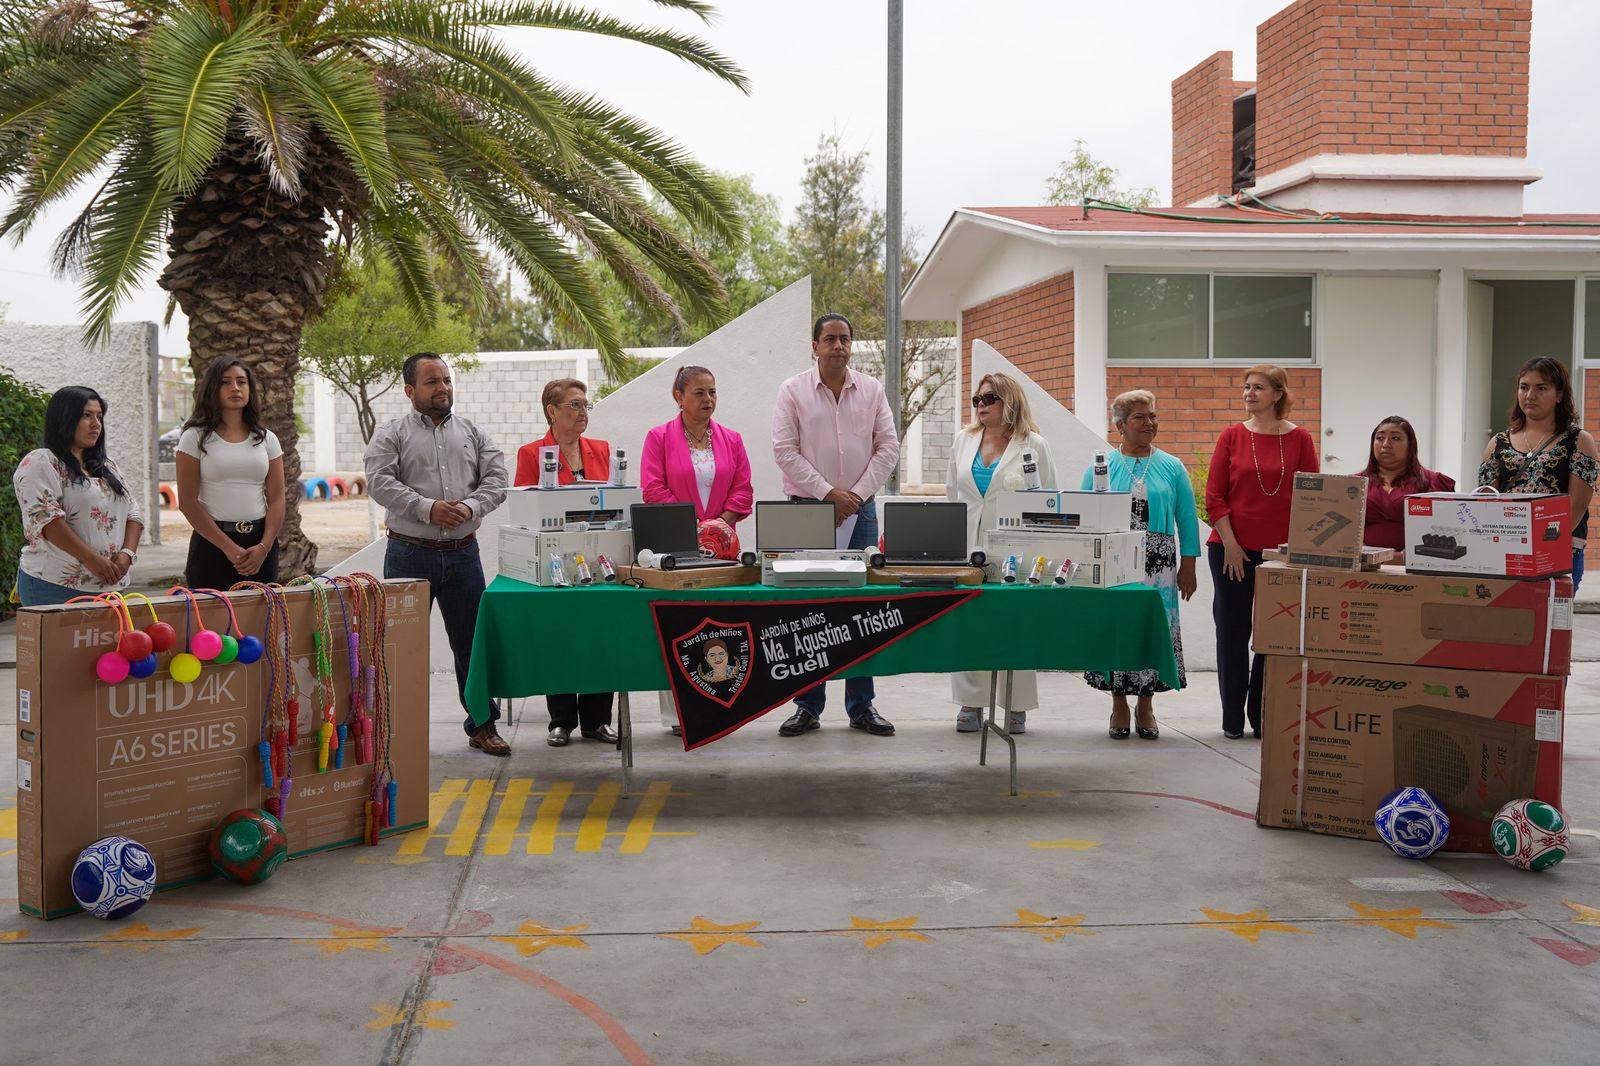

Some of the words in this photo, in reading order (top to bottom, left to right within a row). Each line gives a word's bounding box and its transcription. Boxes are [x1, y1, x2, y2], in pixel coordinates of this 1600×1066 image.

[1368, 582, 1415, 592] mirage
[682, 632, 708, 648] Jardín
[720, 628, 742, 637] Niños
[760, 619, 789, 640] JARDÍN
[790, 621, 801, 632] DE
[801, 612, 826, 628] NIÑOS
[762, 639, 789, 664] Ma.
[794, 624, 852, 658] Agustina
[852, 602, 904, 638] Tristán
[770, 651, 830, 680] Guell
[108, 678, 194, 718] UHD
[196, 671, 236, 705] 4K
[689, 670, 717, 696] Agustina
[1332, 675, 1407, 692] mirage
[110, 736, 146, 766] A6
[151, 722, 236, 758] SERIES
[1327, 737, 1352, 746] CONTROL
[1320, 752, 1347, 760] AMIGABLE
